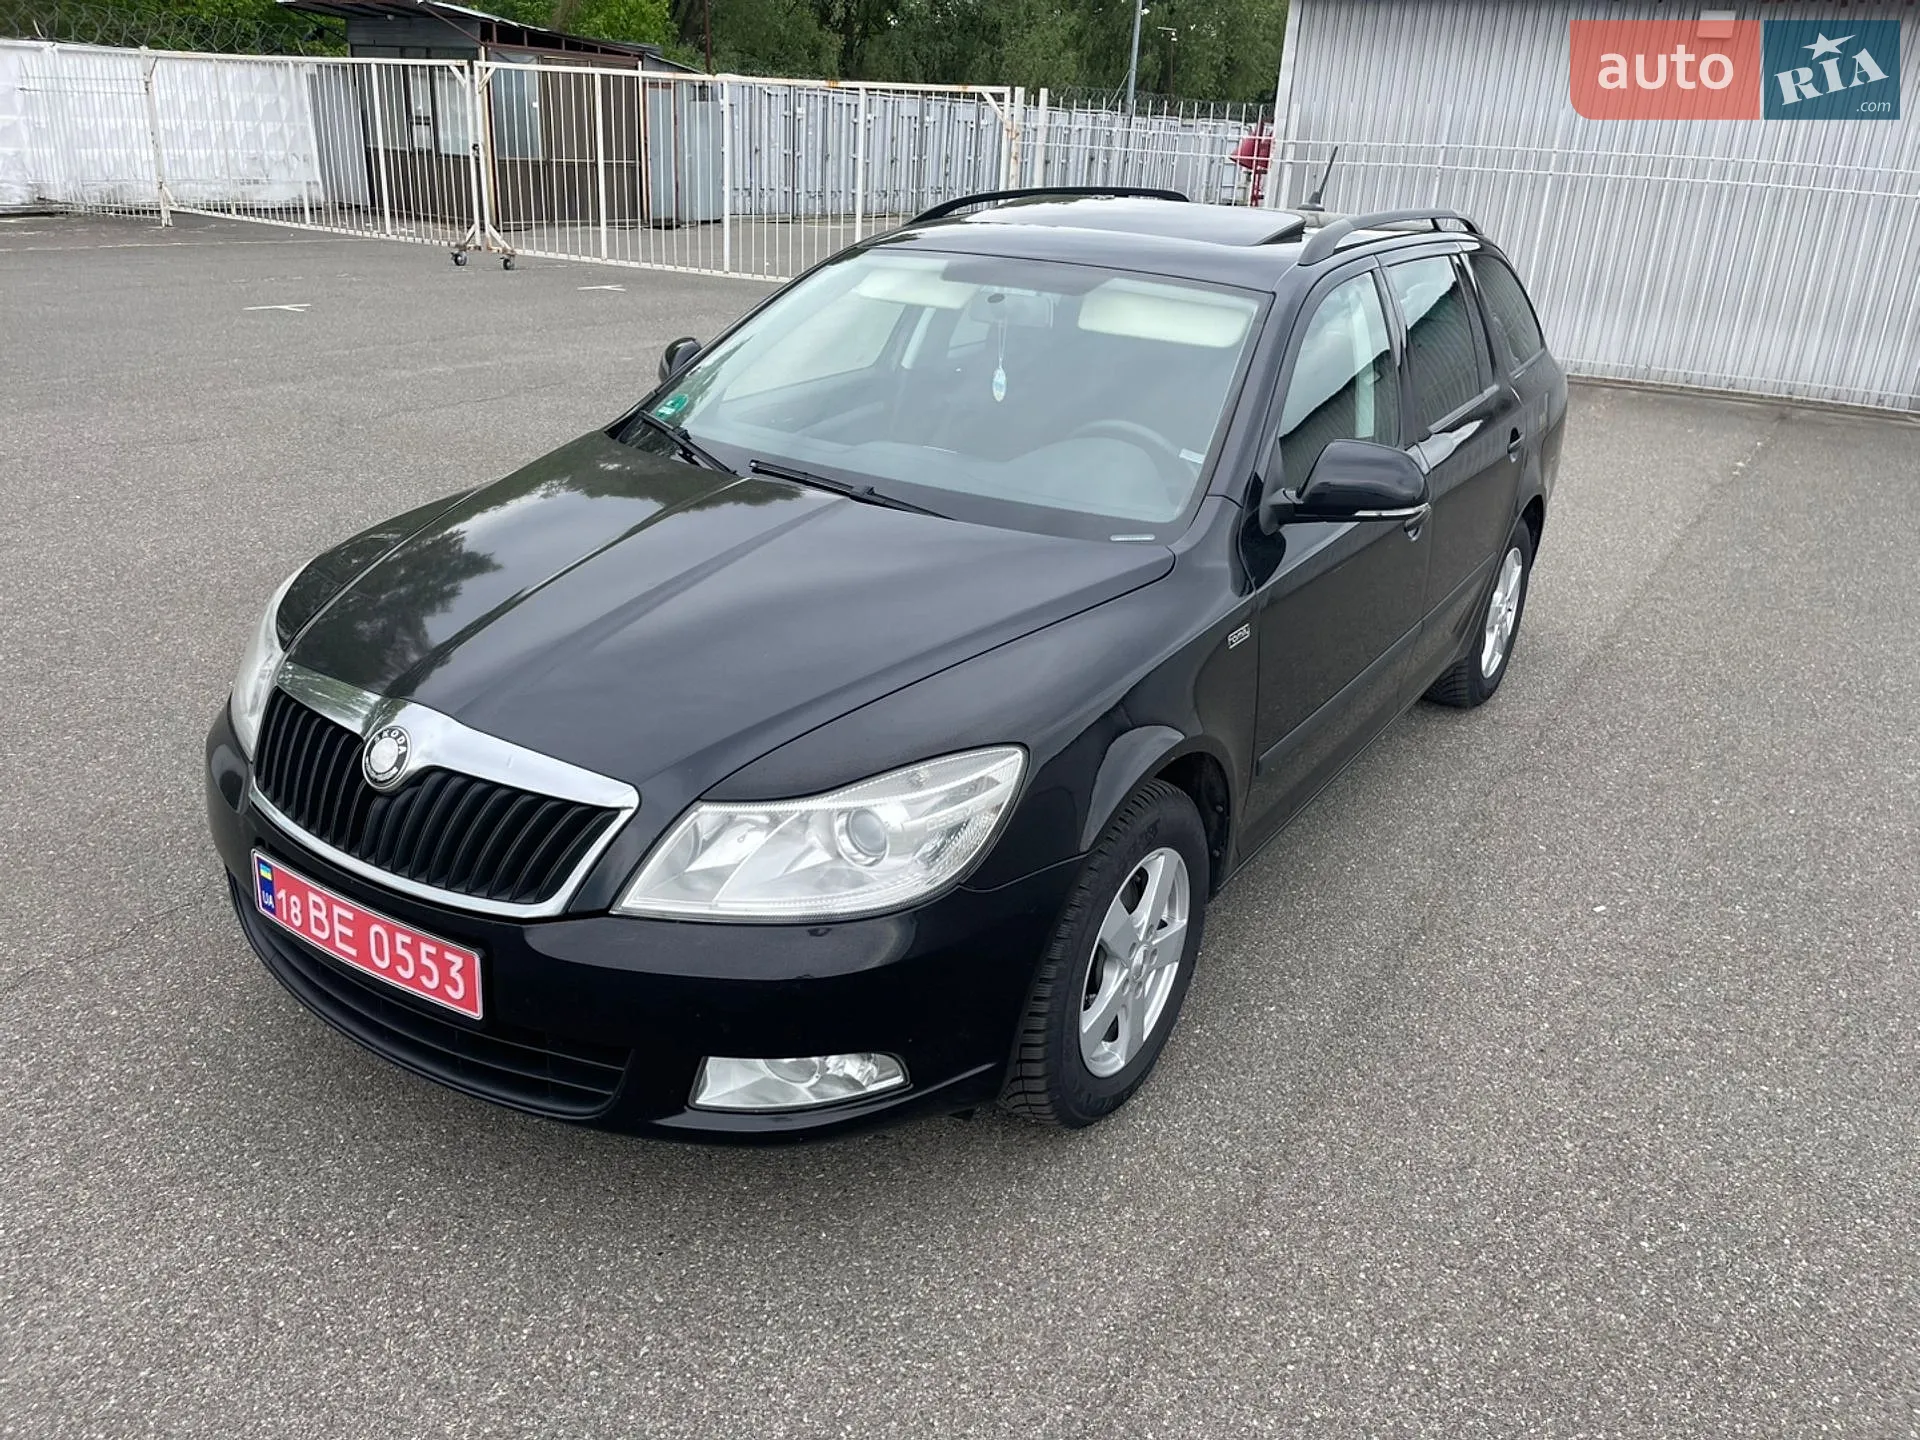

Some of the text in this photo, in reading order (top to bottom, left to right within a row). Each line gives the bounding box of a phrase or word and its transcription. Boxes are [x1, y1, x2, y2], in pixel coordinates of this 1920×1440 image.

[262, 892, 274, 907] UA
[277, 889, 465, 1000] 18 BE 0553
